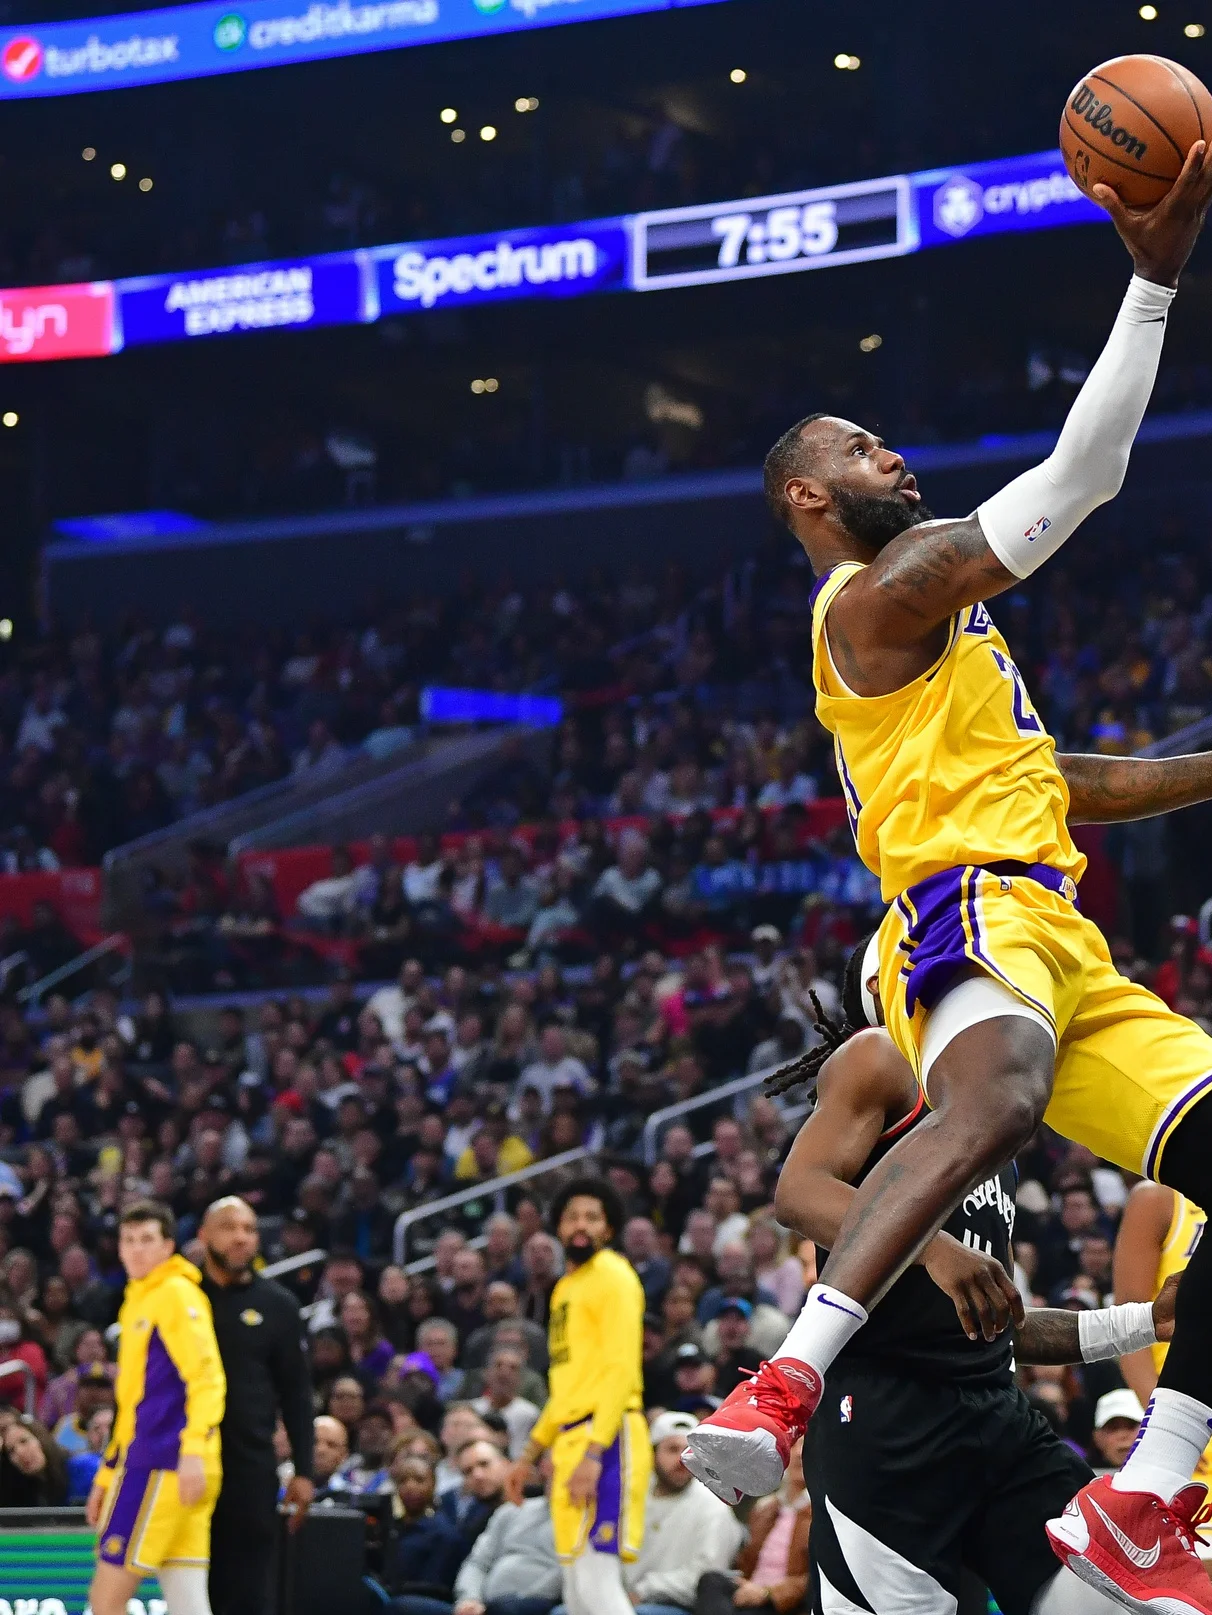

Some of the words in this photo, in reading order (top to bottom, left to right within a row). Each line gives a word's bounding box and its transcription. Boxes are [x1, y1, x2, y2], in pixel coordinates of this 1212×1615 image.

[44, 34, 180, 78] turbotax
[1070, 83, 1148, 161] Wilson
[711, 202, 839, 269] 7:55
[165, 266, 313, 313] AMERICAN
[393, 239, 598, 308] Spectrum
[184, 293, 315, 337] EXPRESS
